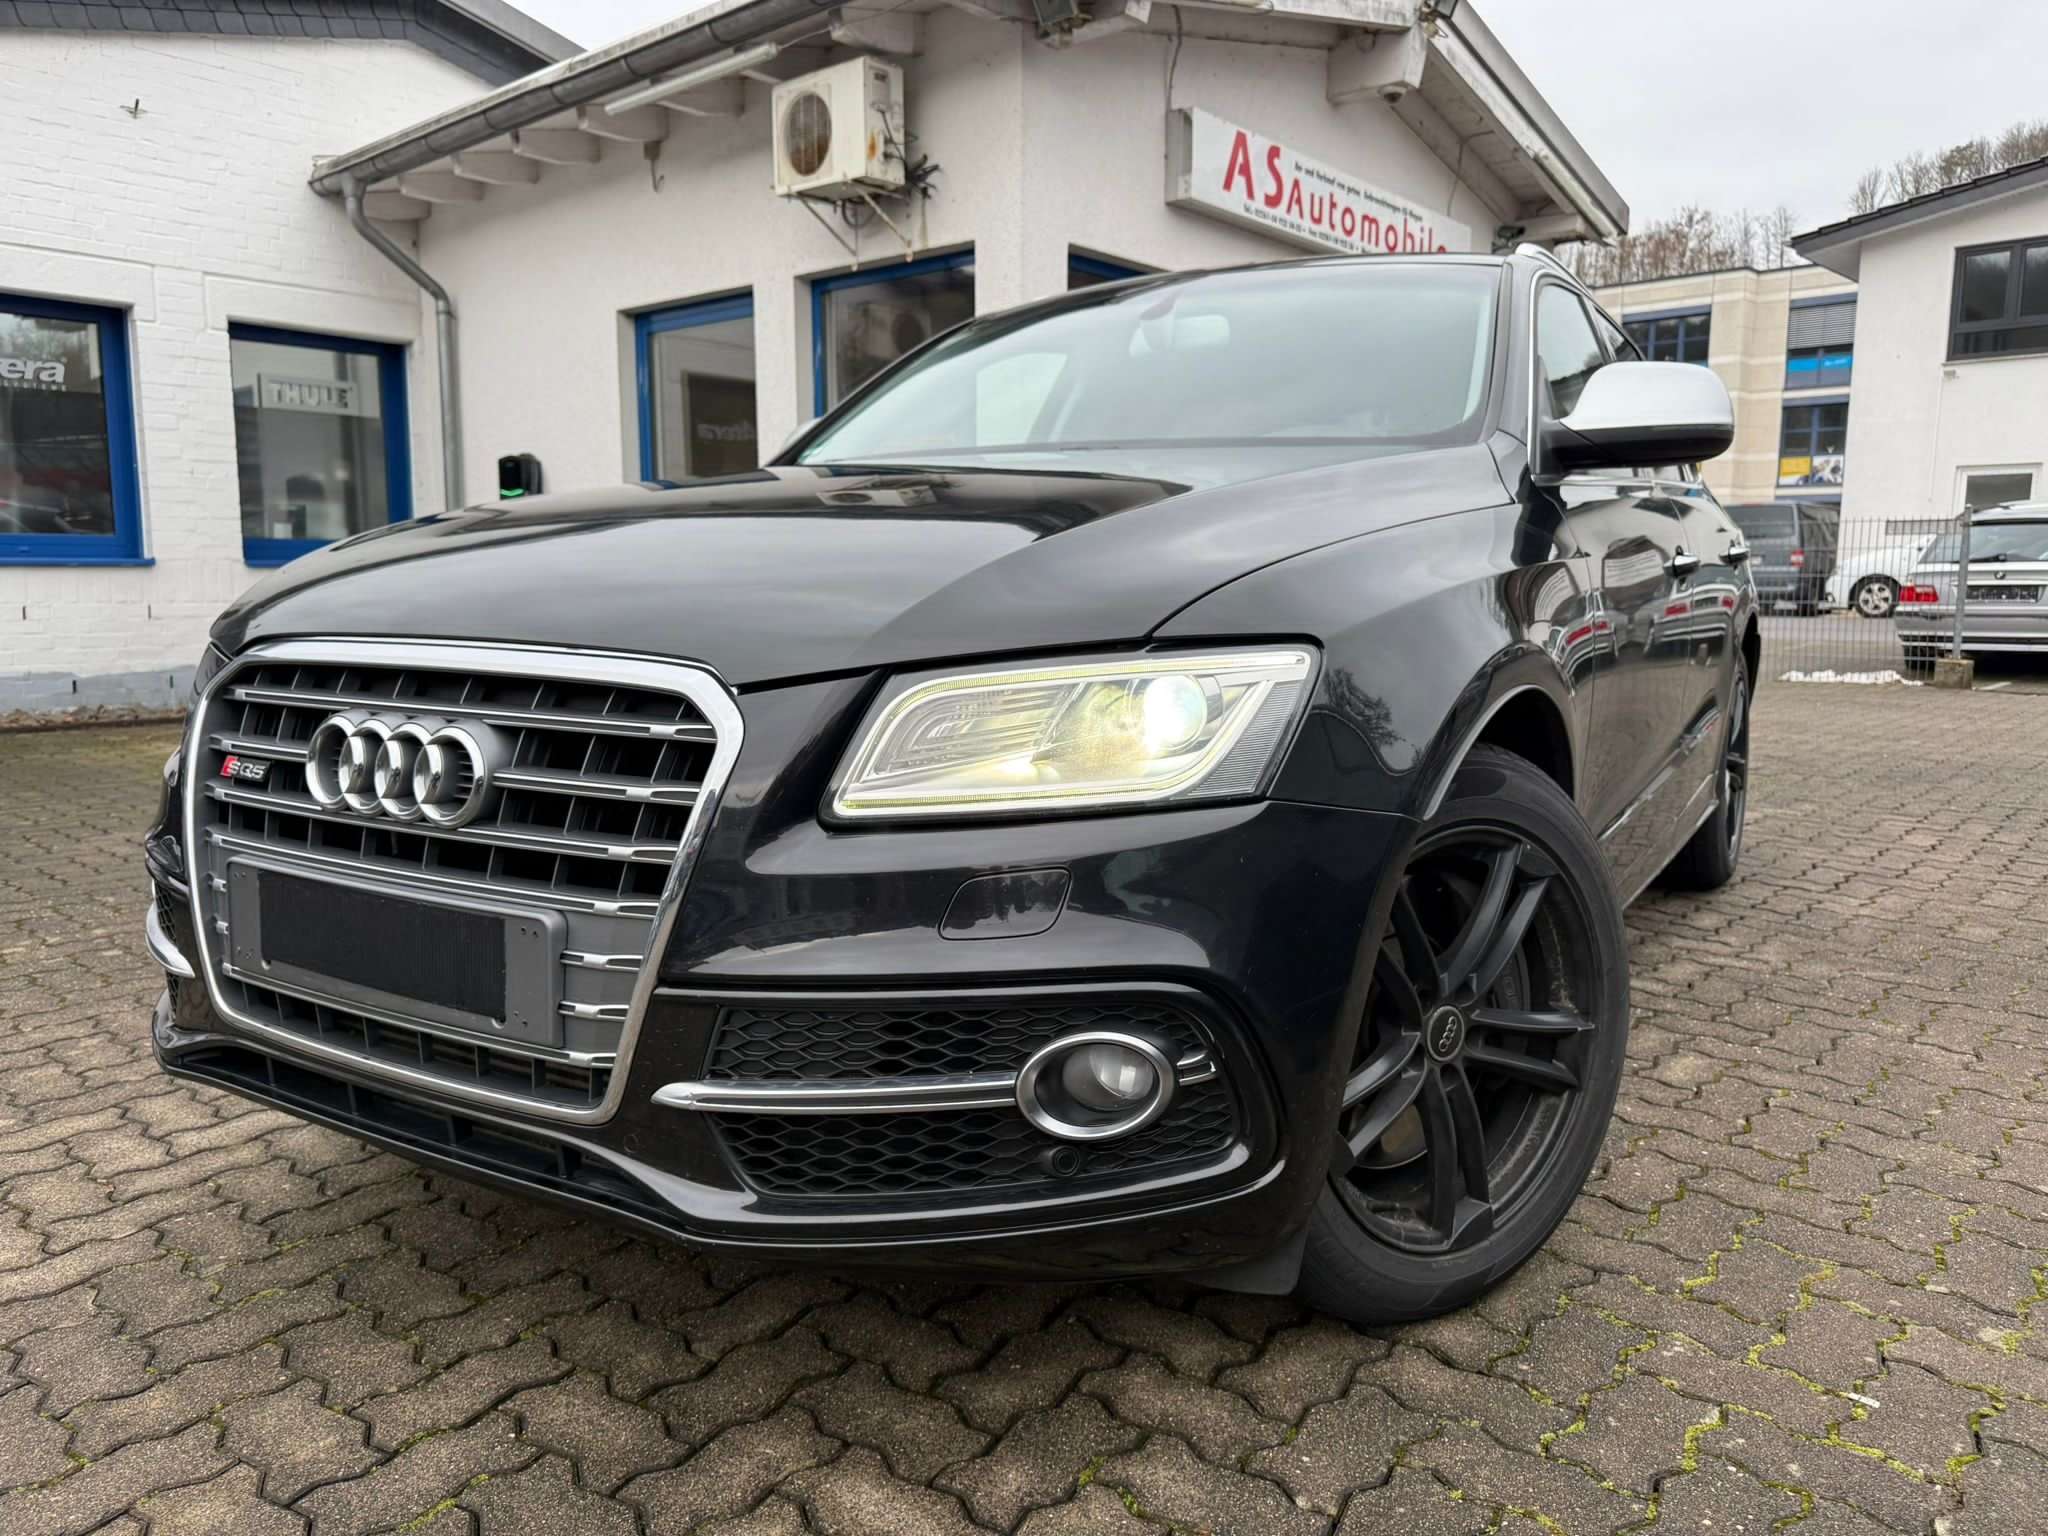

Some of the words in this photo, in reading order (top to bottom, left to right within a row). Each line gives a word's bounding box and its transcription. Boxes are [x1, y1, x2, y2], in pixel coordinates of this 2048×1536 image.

[1222, 130, 1284, 208] AS
[269, 383, 349, 408] THULE
[229, 760, 267, 780] SQ5
